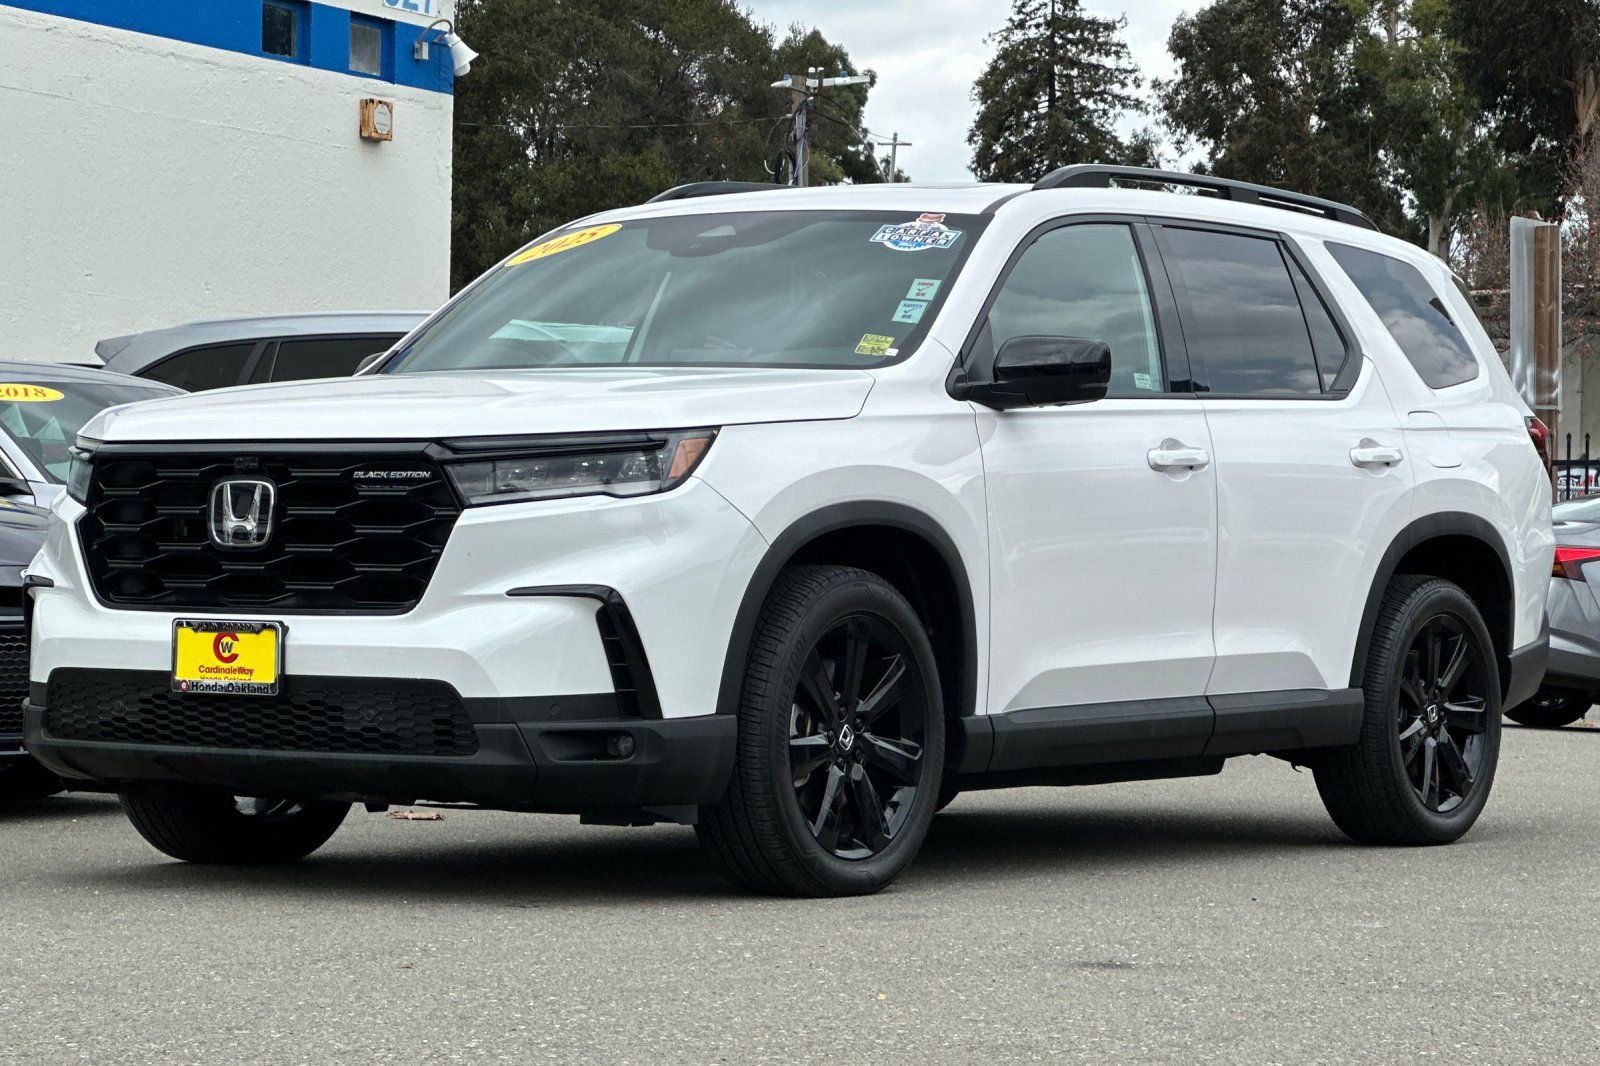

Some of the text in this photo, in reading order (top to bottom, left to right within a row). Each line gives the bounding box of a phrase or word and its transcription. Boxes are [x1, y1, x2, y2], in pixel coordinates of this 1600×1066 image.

[883, 226, 954, 239] CARFAX
[889, 233, 947, 246] OWNER
[0, 387, 47, 398] 2018
[353, 471, 431, 479] BLACK EDITION
[198, 665, 254, 676] CardinaleWay
[191, 681, 270, 694] Honda Oakland
